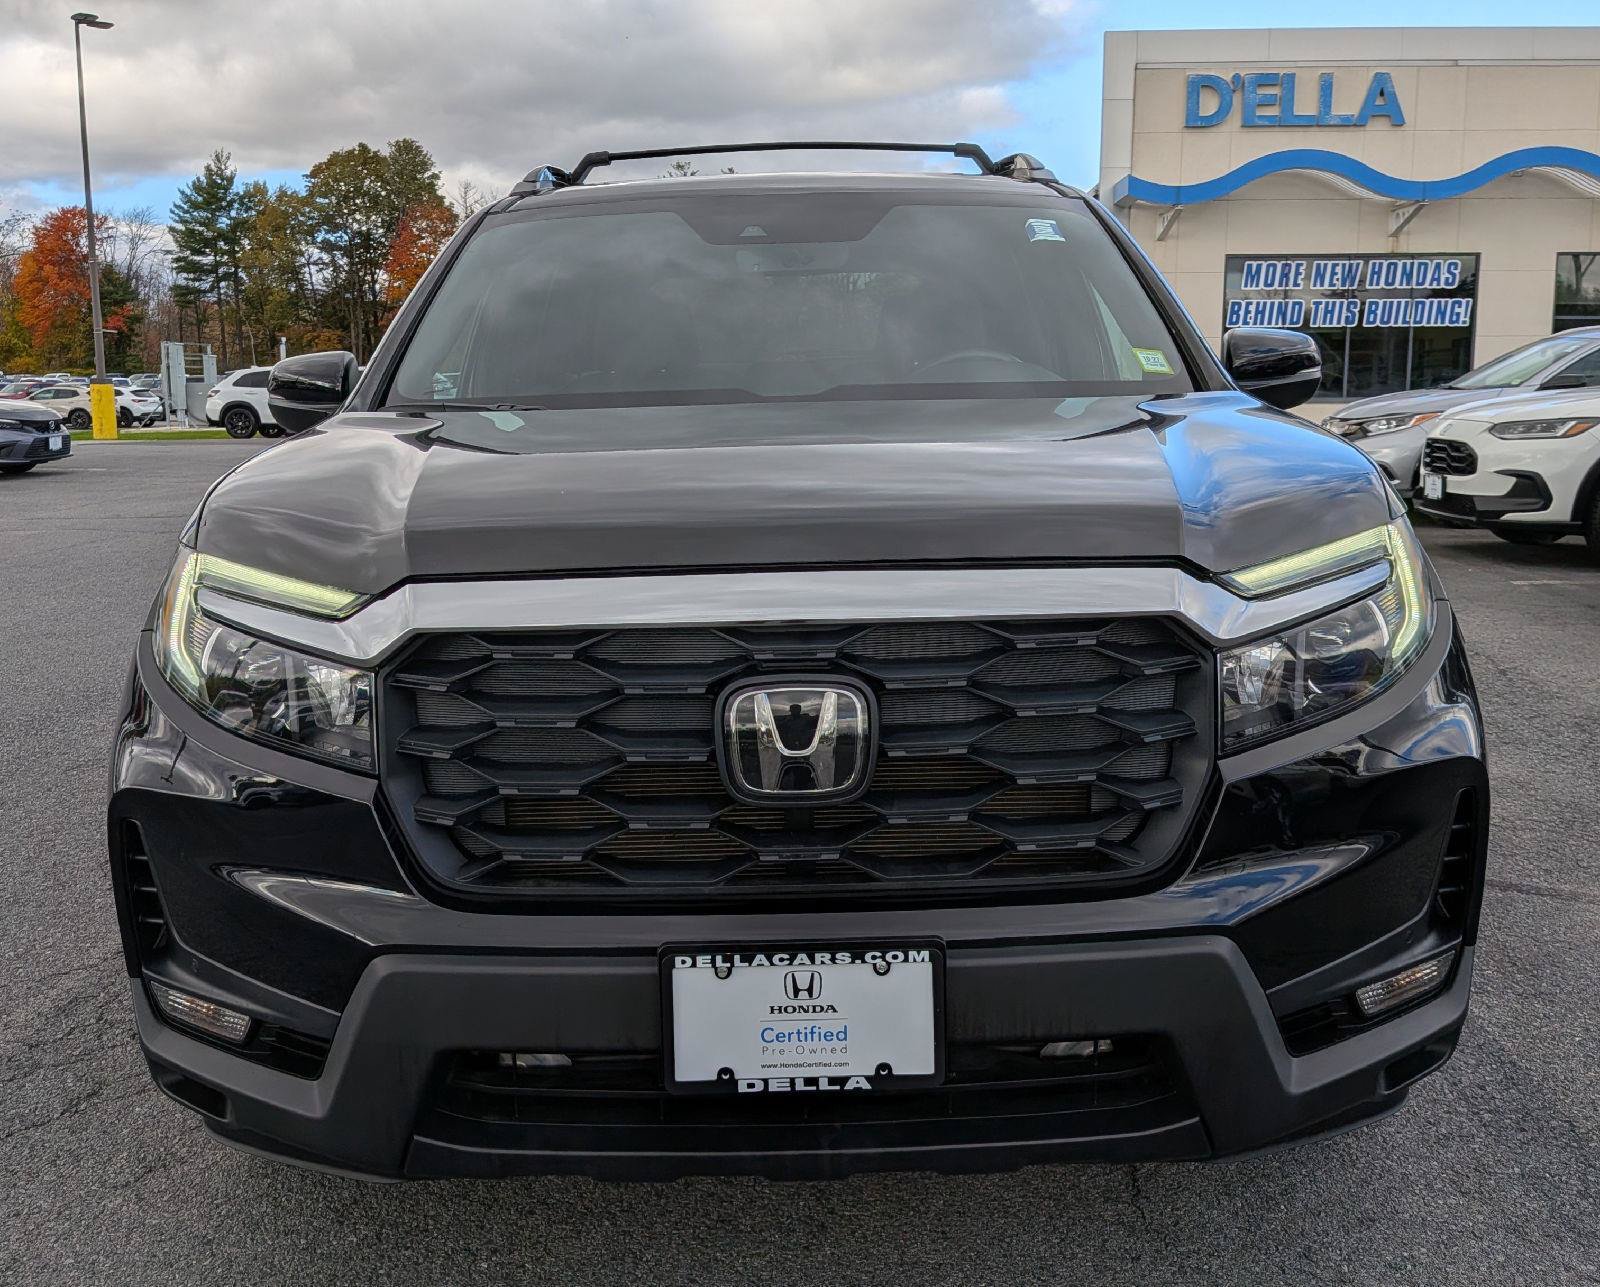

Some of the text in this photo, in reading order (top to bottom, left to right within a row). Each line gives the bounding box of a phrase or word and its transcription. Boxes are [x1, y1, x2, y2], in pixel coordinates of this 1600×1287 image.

[1184, 72, 1406, 128] D'ELLA
[1242, 259, 1461, 290] MORE NEW HONDAS
[1226, 298, 1473, 328] BEHIND THIS BUILDING!
[674, 950, 930, 968] DELLACARS.COM
[768, 1003, 839, 1015] HONDA
[760, 1024, 848, 1044] Certified
[761, 1044, 848, 1056] Pre-Owned
[760, 1060, 850, 1069] www.HondaCertified.com
[737, 1076, 873, 1093] DELLA
